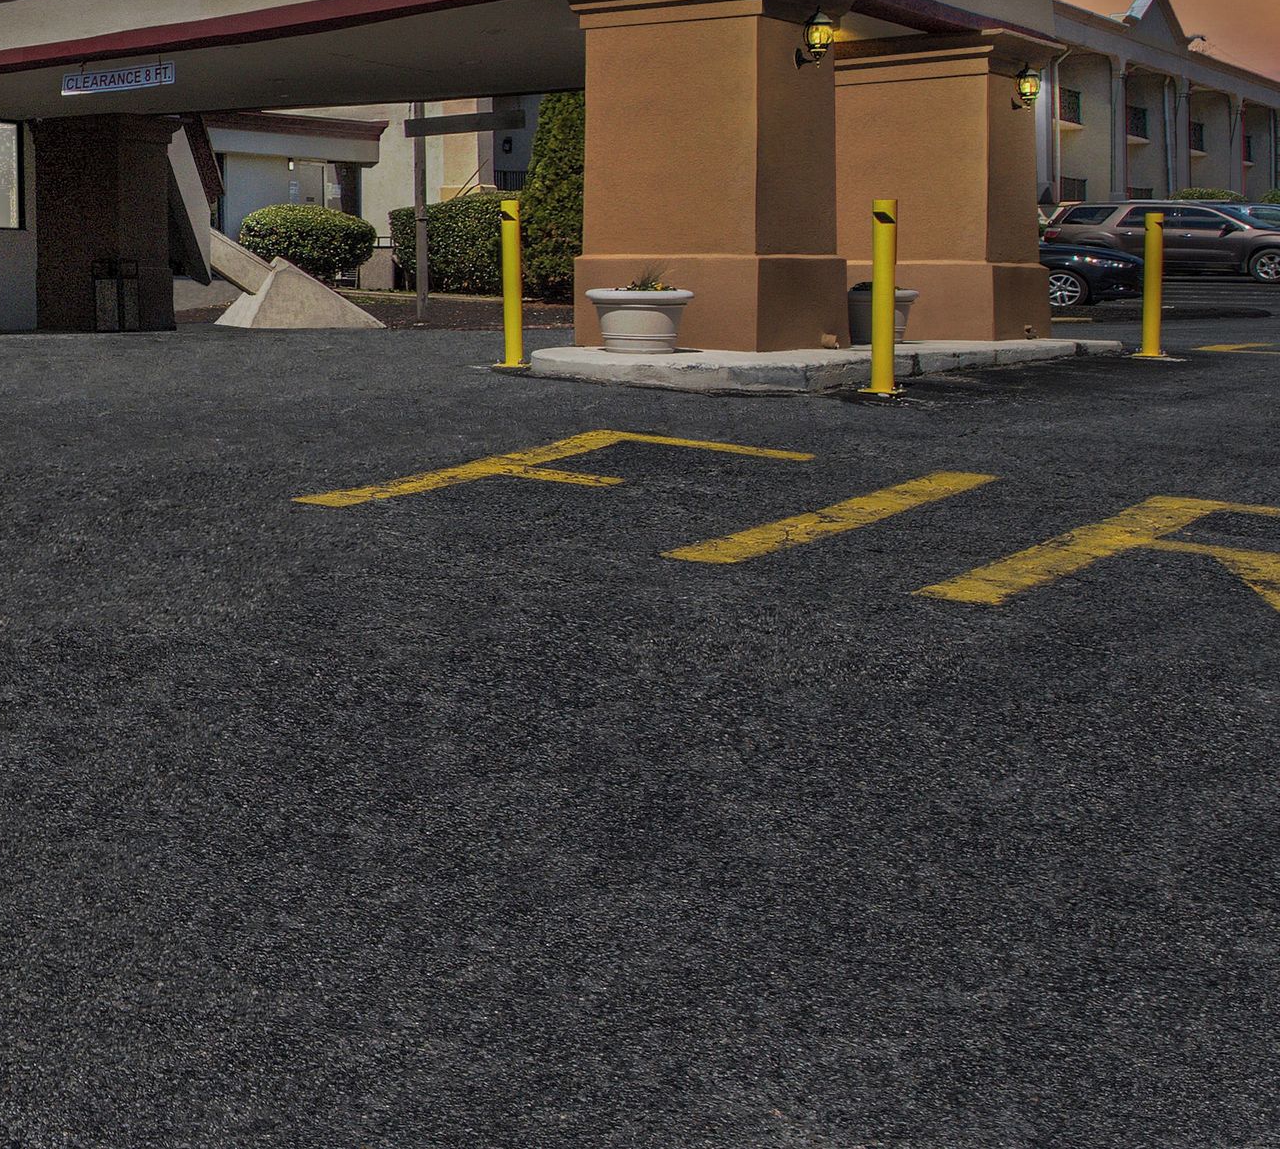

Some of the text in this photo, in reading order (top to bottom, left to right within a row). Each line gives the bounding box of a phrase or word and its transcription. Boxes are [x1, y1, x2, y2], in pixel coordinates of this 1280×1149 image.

[66, 66, 171, 90] CLEARANCE 8 FT.
